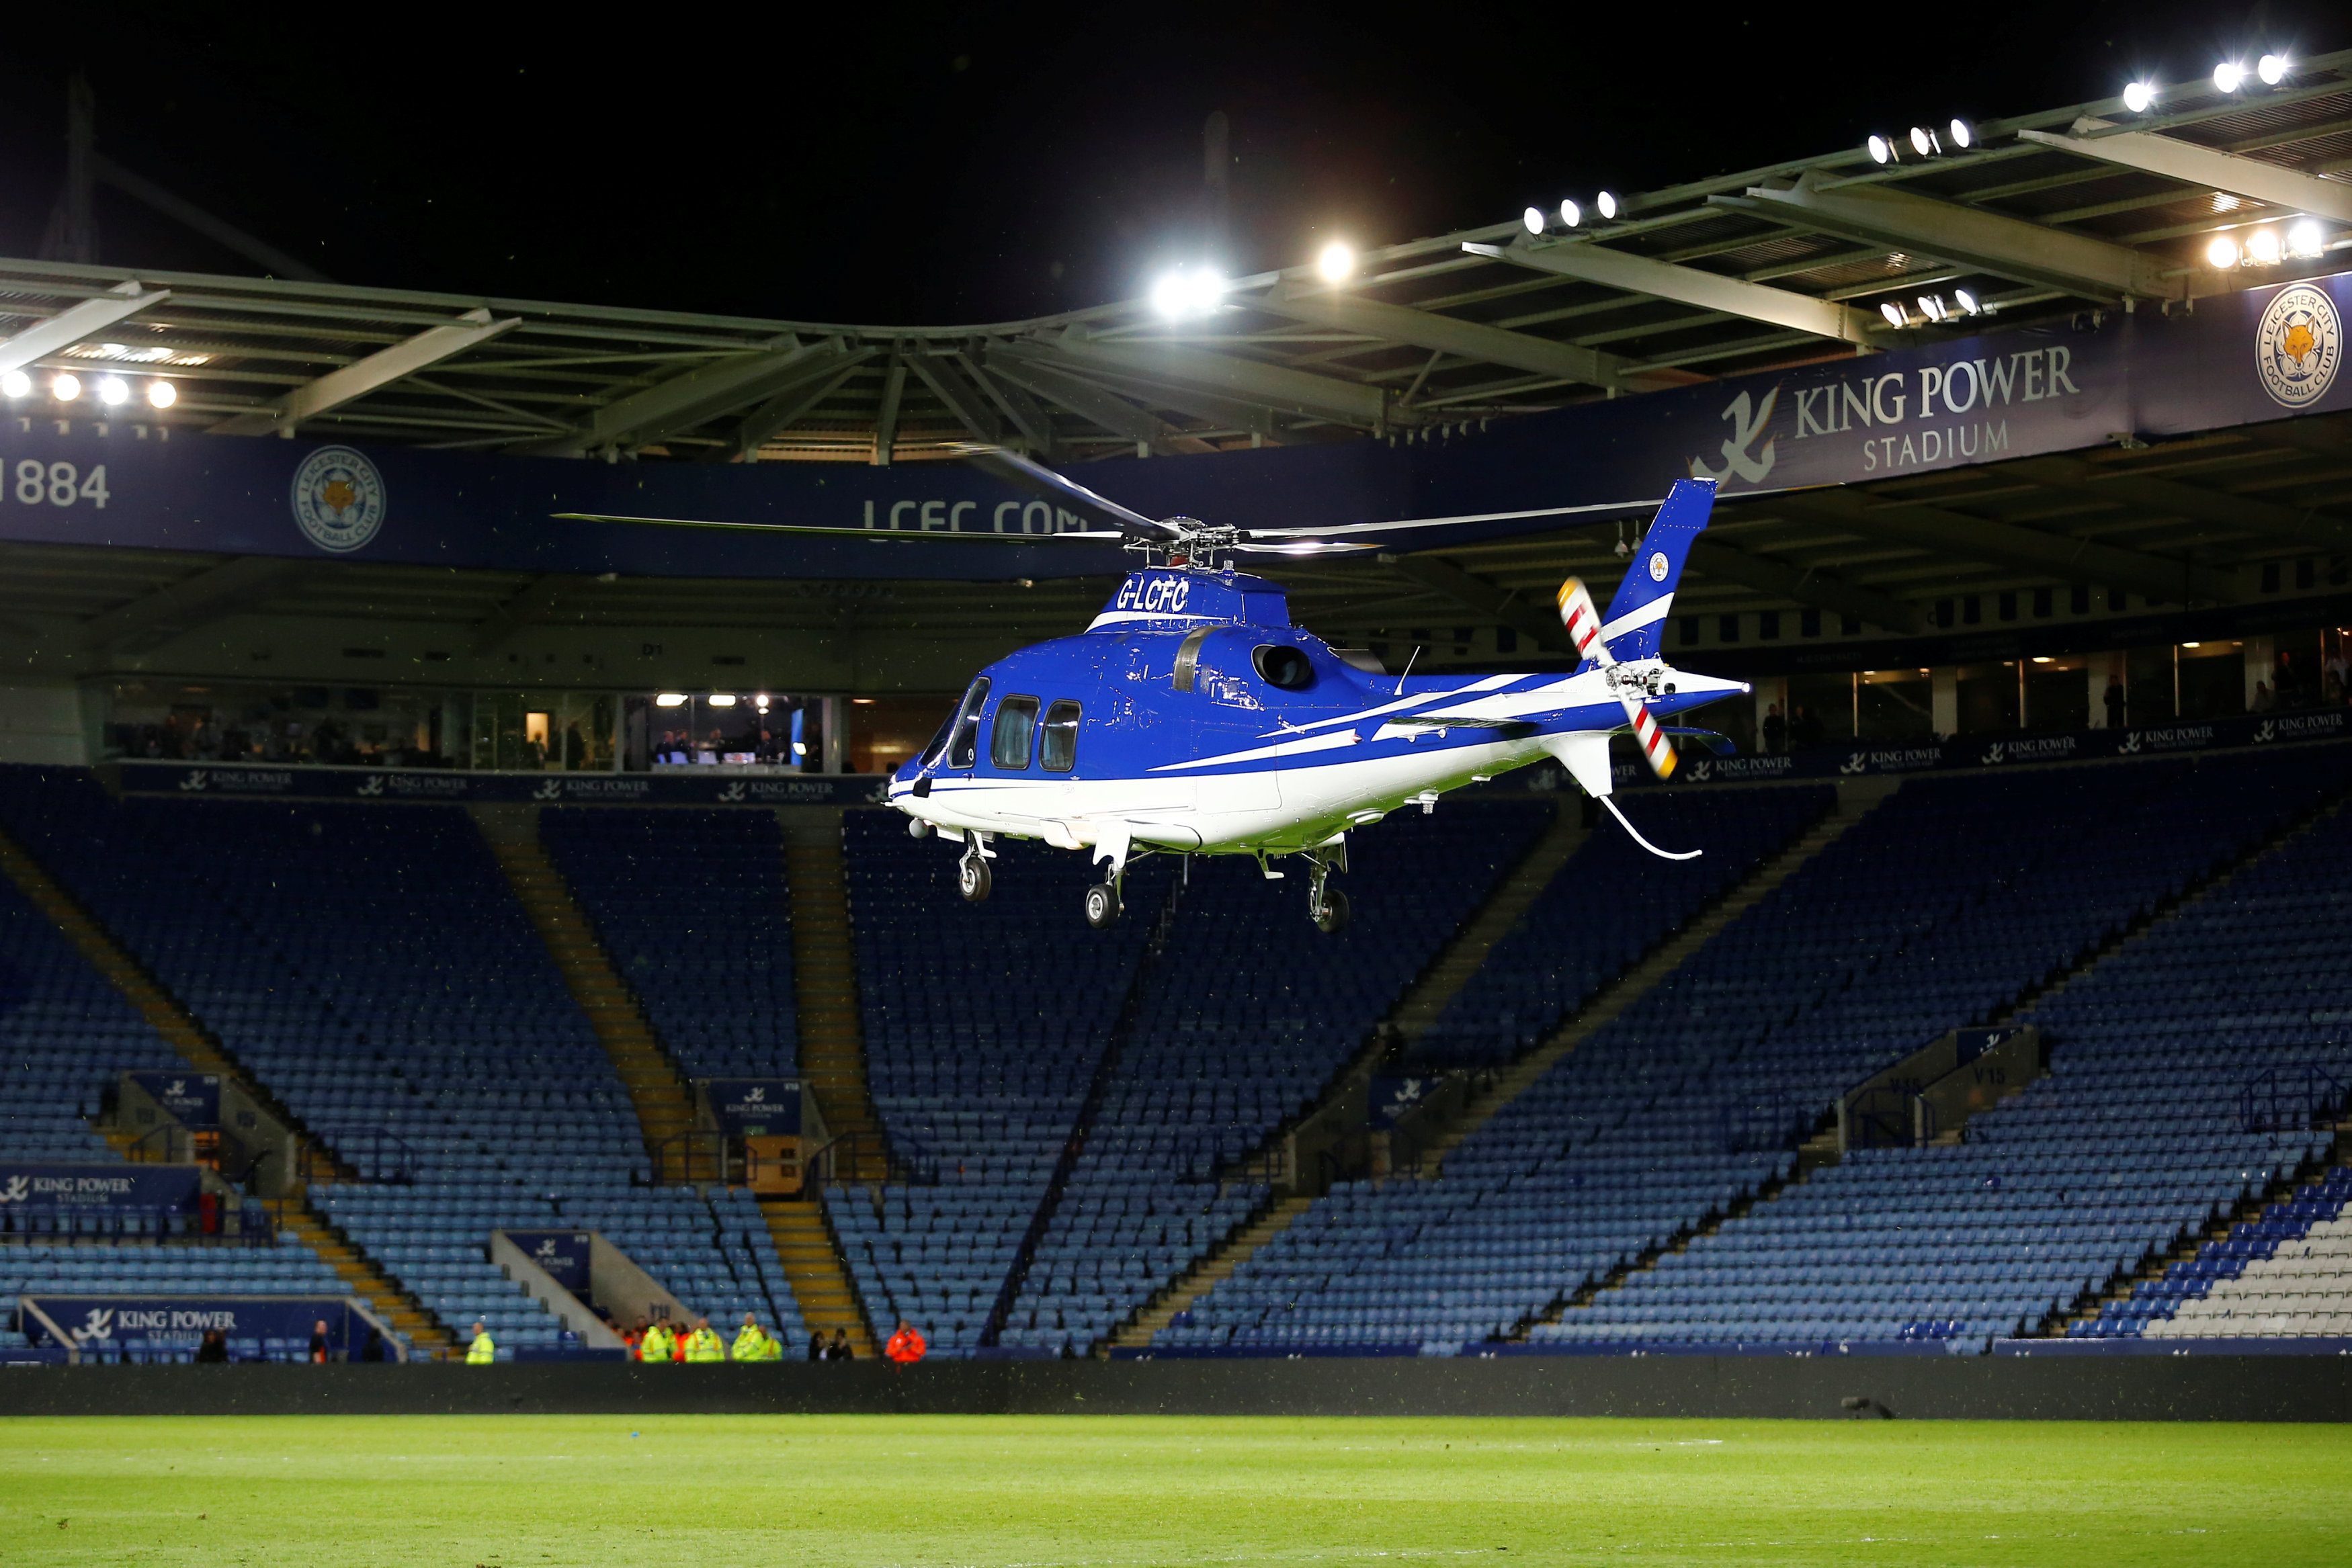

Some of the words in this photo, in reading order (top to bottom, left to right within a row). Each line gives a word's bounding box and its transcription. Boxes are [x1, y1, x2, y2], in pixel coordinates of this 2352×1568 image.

[2264, 295, 2317, 345] LEICESTER
[2317, 304, 2335, 336] CITY
[2264, 356, 2314, 397] FOOTBALL
[2314, 346, 2335, 386] CLUB
[1794, 373, 1906, 439] KING
[1919, 345, 2080, 419] POWER
[1864, 419, 2009, 471] STADIUM
[302, 455, 360, 492] LEICESTER
[359, 468, 378, 496] CITY
[302, 501, 351, 541] FOOTBALL
[355, 505, 377, 535] CLUB
[1117, 578, 1189, 612] G-LCFC
[2279, 717, 2304, 731] KING
[2308, 713, 2344, 728] POWER
[2146, 728, 2173, 743] KING
[2177, 726, 2214, 741] POWER
[2009, 740, 2035, 752] KING
[2038, 736, 2076, 750] POWER
[1871, 750, 1902, 763] KING
[1905, 748, 1942, 760] POWER
[1611, 765, 1637, 776] WER
[1716, 758, 1746, 771] KING
[1750, 757, 1792, 769] POWER
[212, 771, 245, 782] KING
[248, 772, 292, 784] POWER
[388, 777, 421, 787] KING
[424, 777, 468, 789] POWER
[566, 780, 600, 791] KING
[603, 781, 649, 791] POWER
[751, 782, 784, 793] KING
[788, 783, 833, 793] POWER
[1974, 1067, 2005, 1084] V15
[751, 1104, 784, 1113] POWER
[34, 1178, 74, 1193] KING
[76, 1178, 132, 1194] POWER
[56, 1193, 109, 1203] STADIUM
[118, 1311, 168, 1330] KING
[171, 1311, 237, 1330] POWER
[147, 1330, 204, 1340] STADIU
